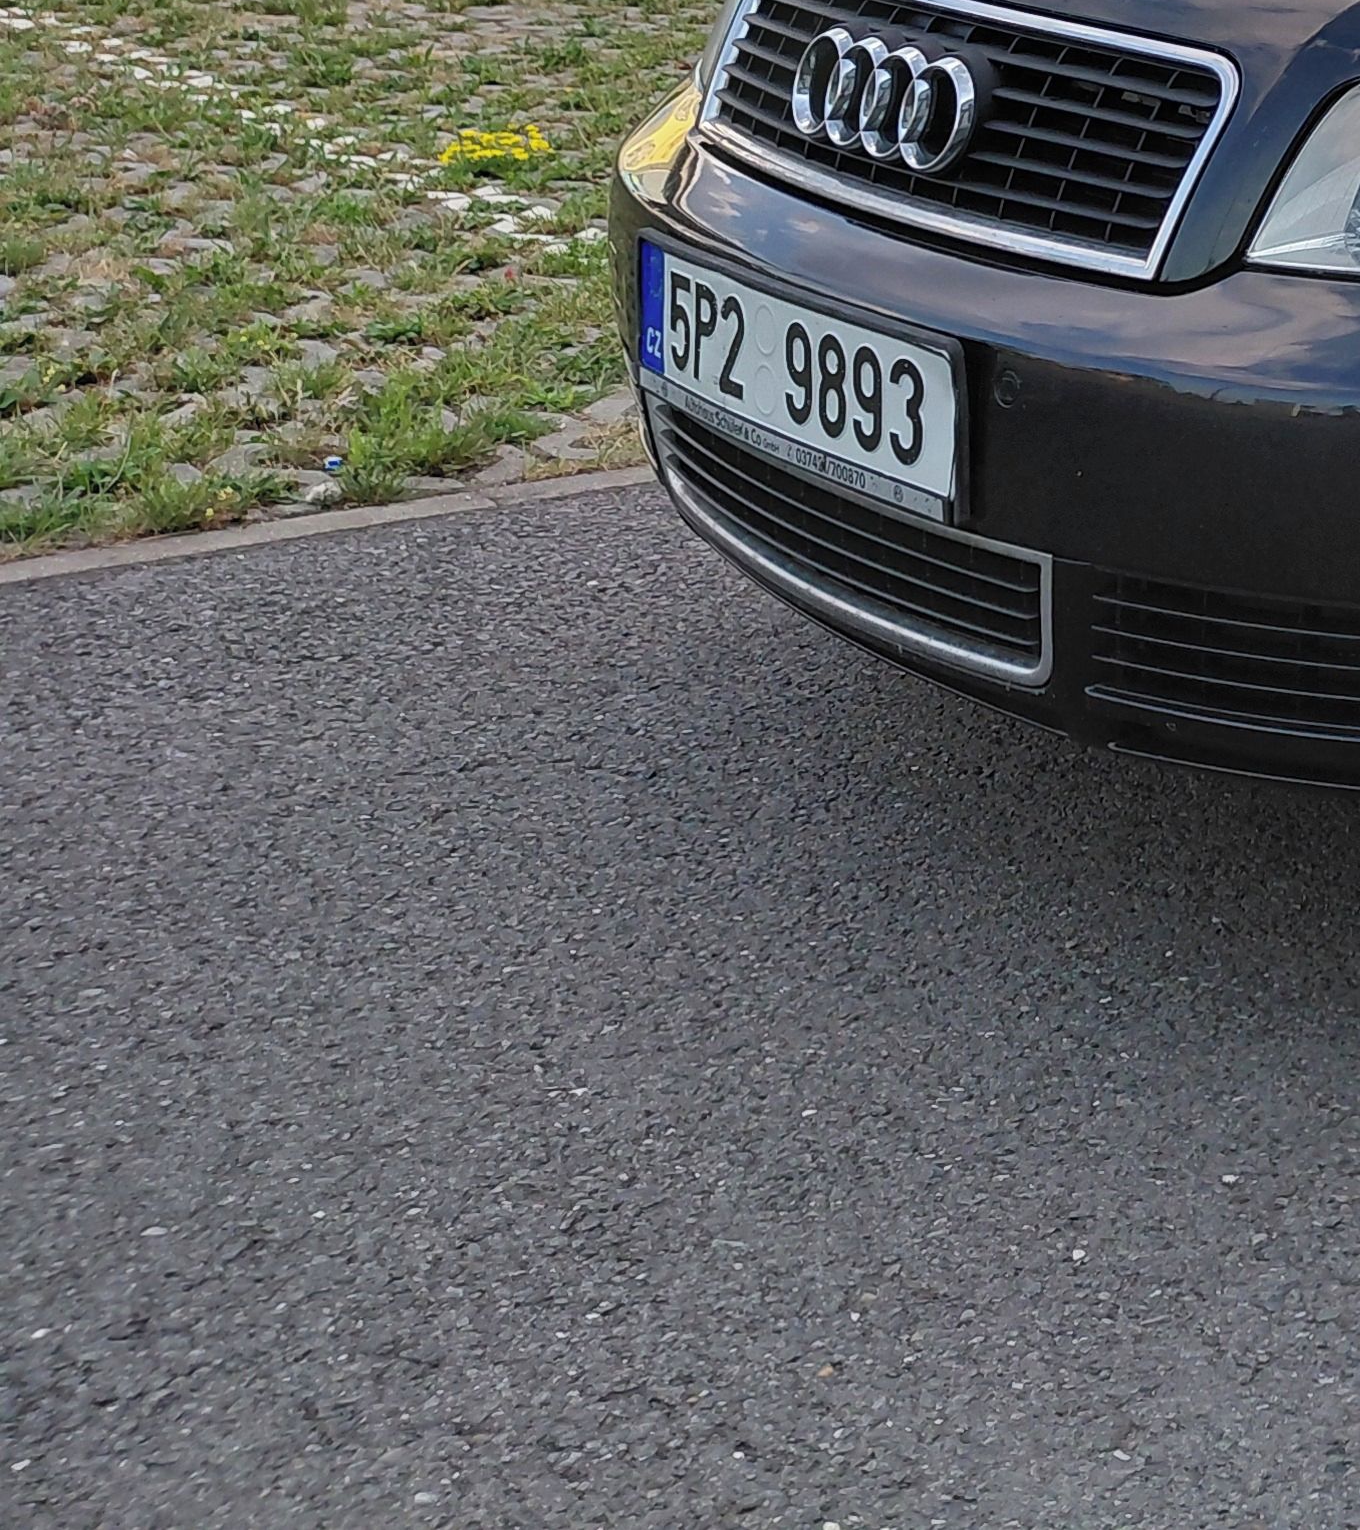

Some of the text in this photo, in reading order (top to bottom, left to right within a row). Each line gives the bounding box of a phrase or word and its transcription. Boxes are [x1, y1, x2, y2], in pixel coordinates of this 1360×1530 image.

[646, 326, 662, 359] CZ
[670, 270, 925, 467] 5P2 9893
